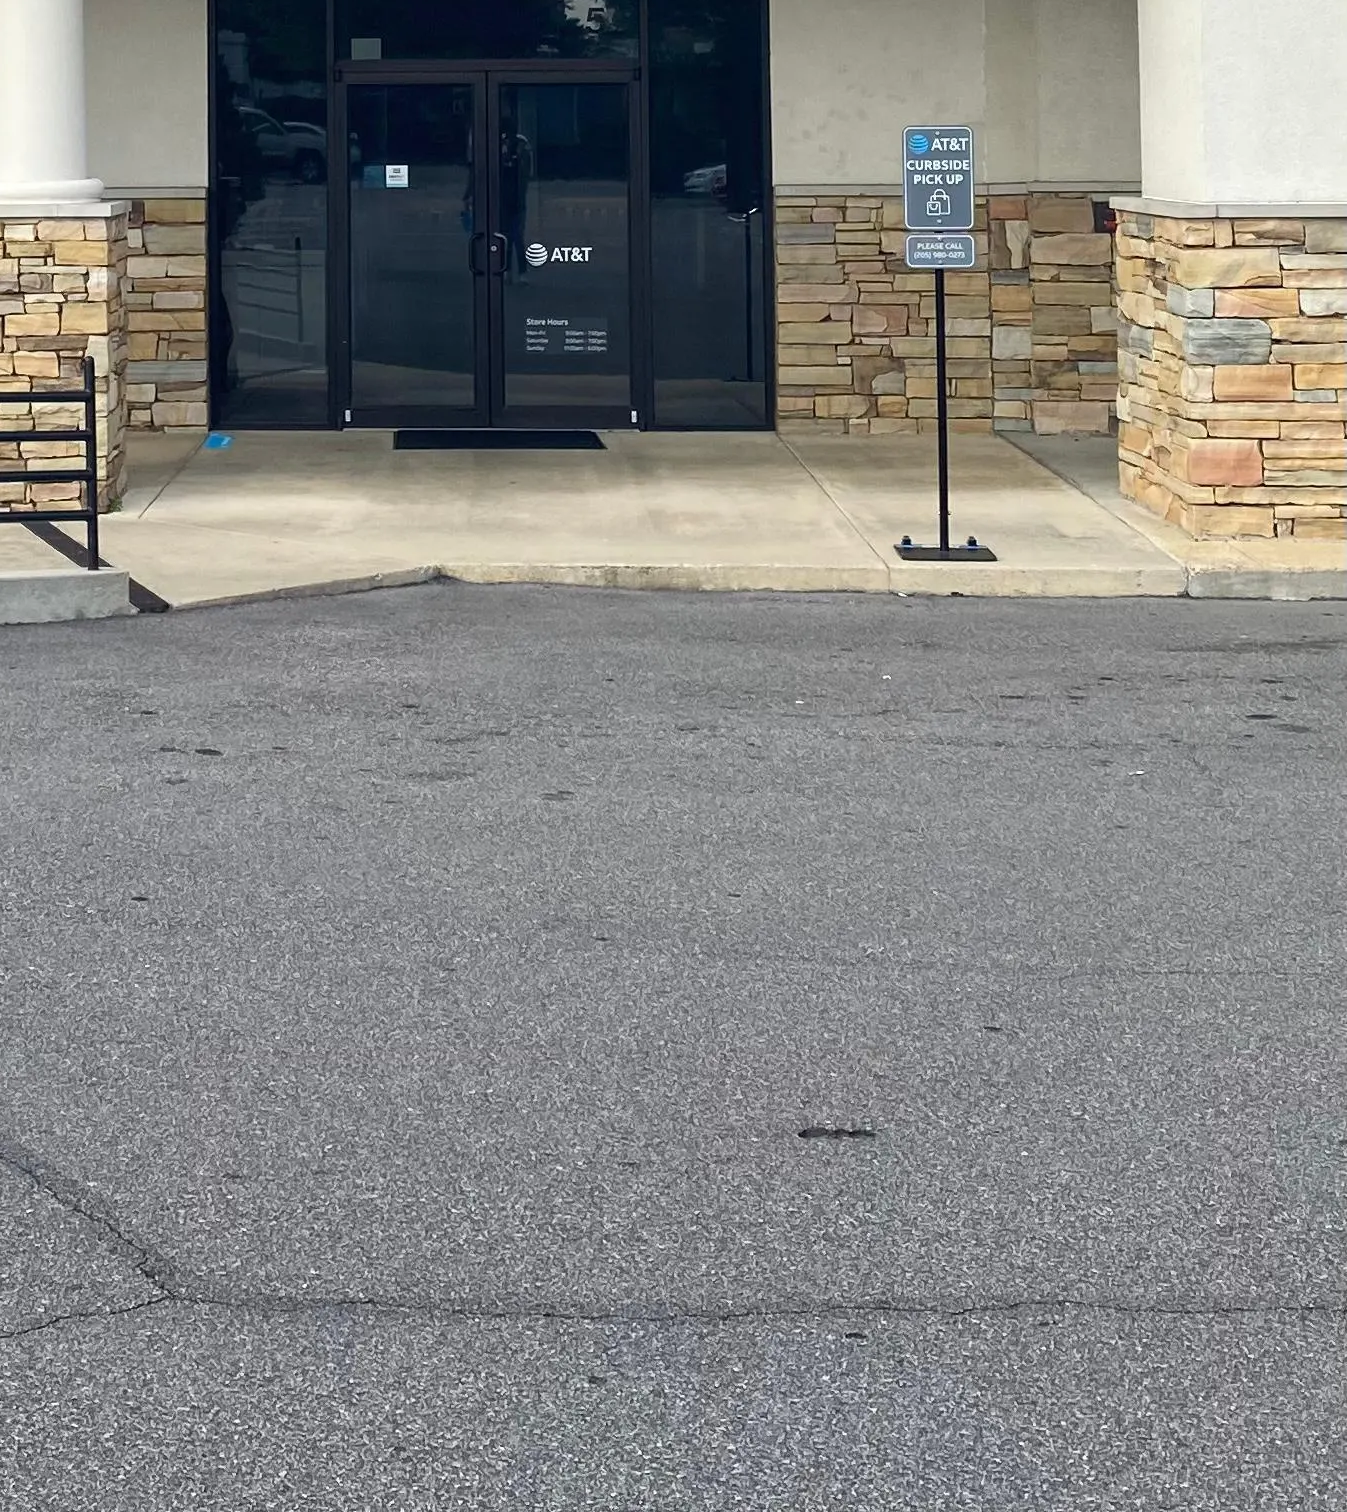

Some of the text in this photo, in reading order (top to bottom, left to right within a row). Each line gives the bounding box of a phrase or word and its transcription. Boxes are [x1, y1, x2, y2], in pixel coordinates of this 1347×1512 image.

[930, 137, 969, 152] AT&T
[906, 159, 970, 171] CURBSIDE
[913, 174, 964, 185] PICK UP
[916, 242, 963, 250] PLEASE CALL
[550, 247, 593, 262] AT&T
[526, 318, 569, 326] Store Hours
